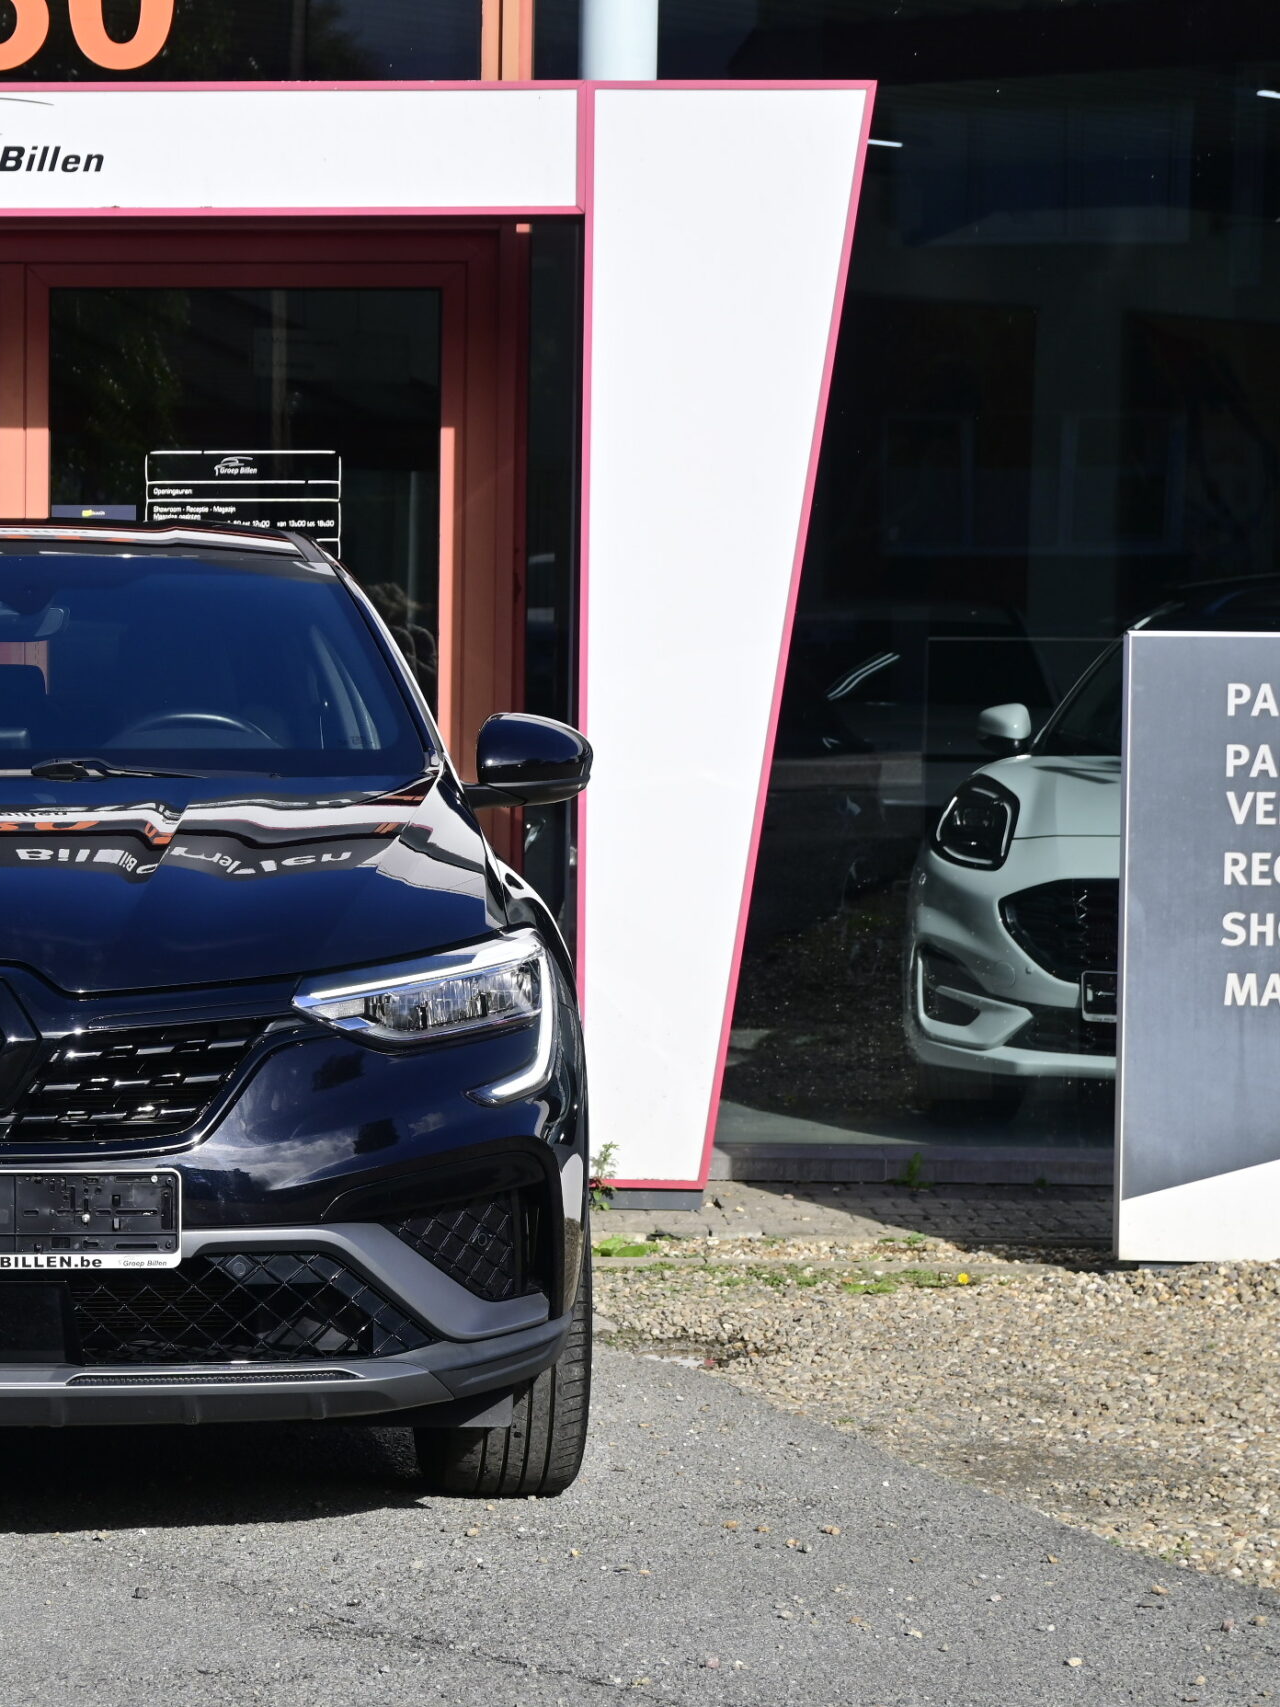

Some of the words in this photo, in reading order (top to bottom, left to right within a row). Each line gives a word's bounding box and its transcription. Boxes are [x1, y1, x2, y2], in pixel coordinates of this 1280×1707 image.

[220, 466, 239, 475] Groep
[240, 466, 258, 474] Billen
[153, 505, 182, 513] Showroom
[186, 505, 209, 514] Receptie
[213, 505, 236, 515] Magazijn
[1226, 791, 1280, 825] VE
[1224, 852, 1280, 886] RE
[1221, 911, 1280, 946] SH
[123, 1260, 145, 1268] Groep
